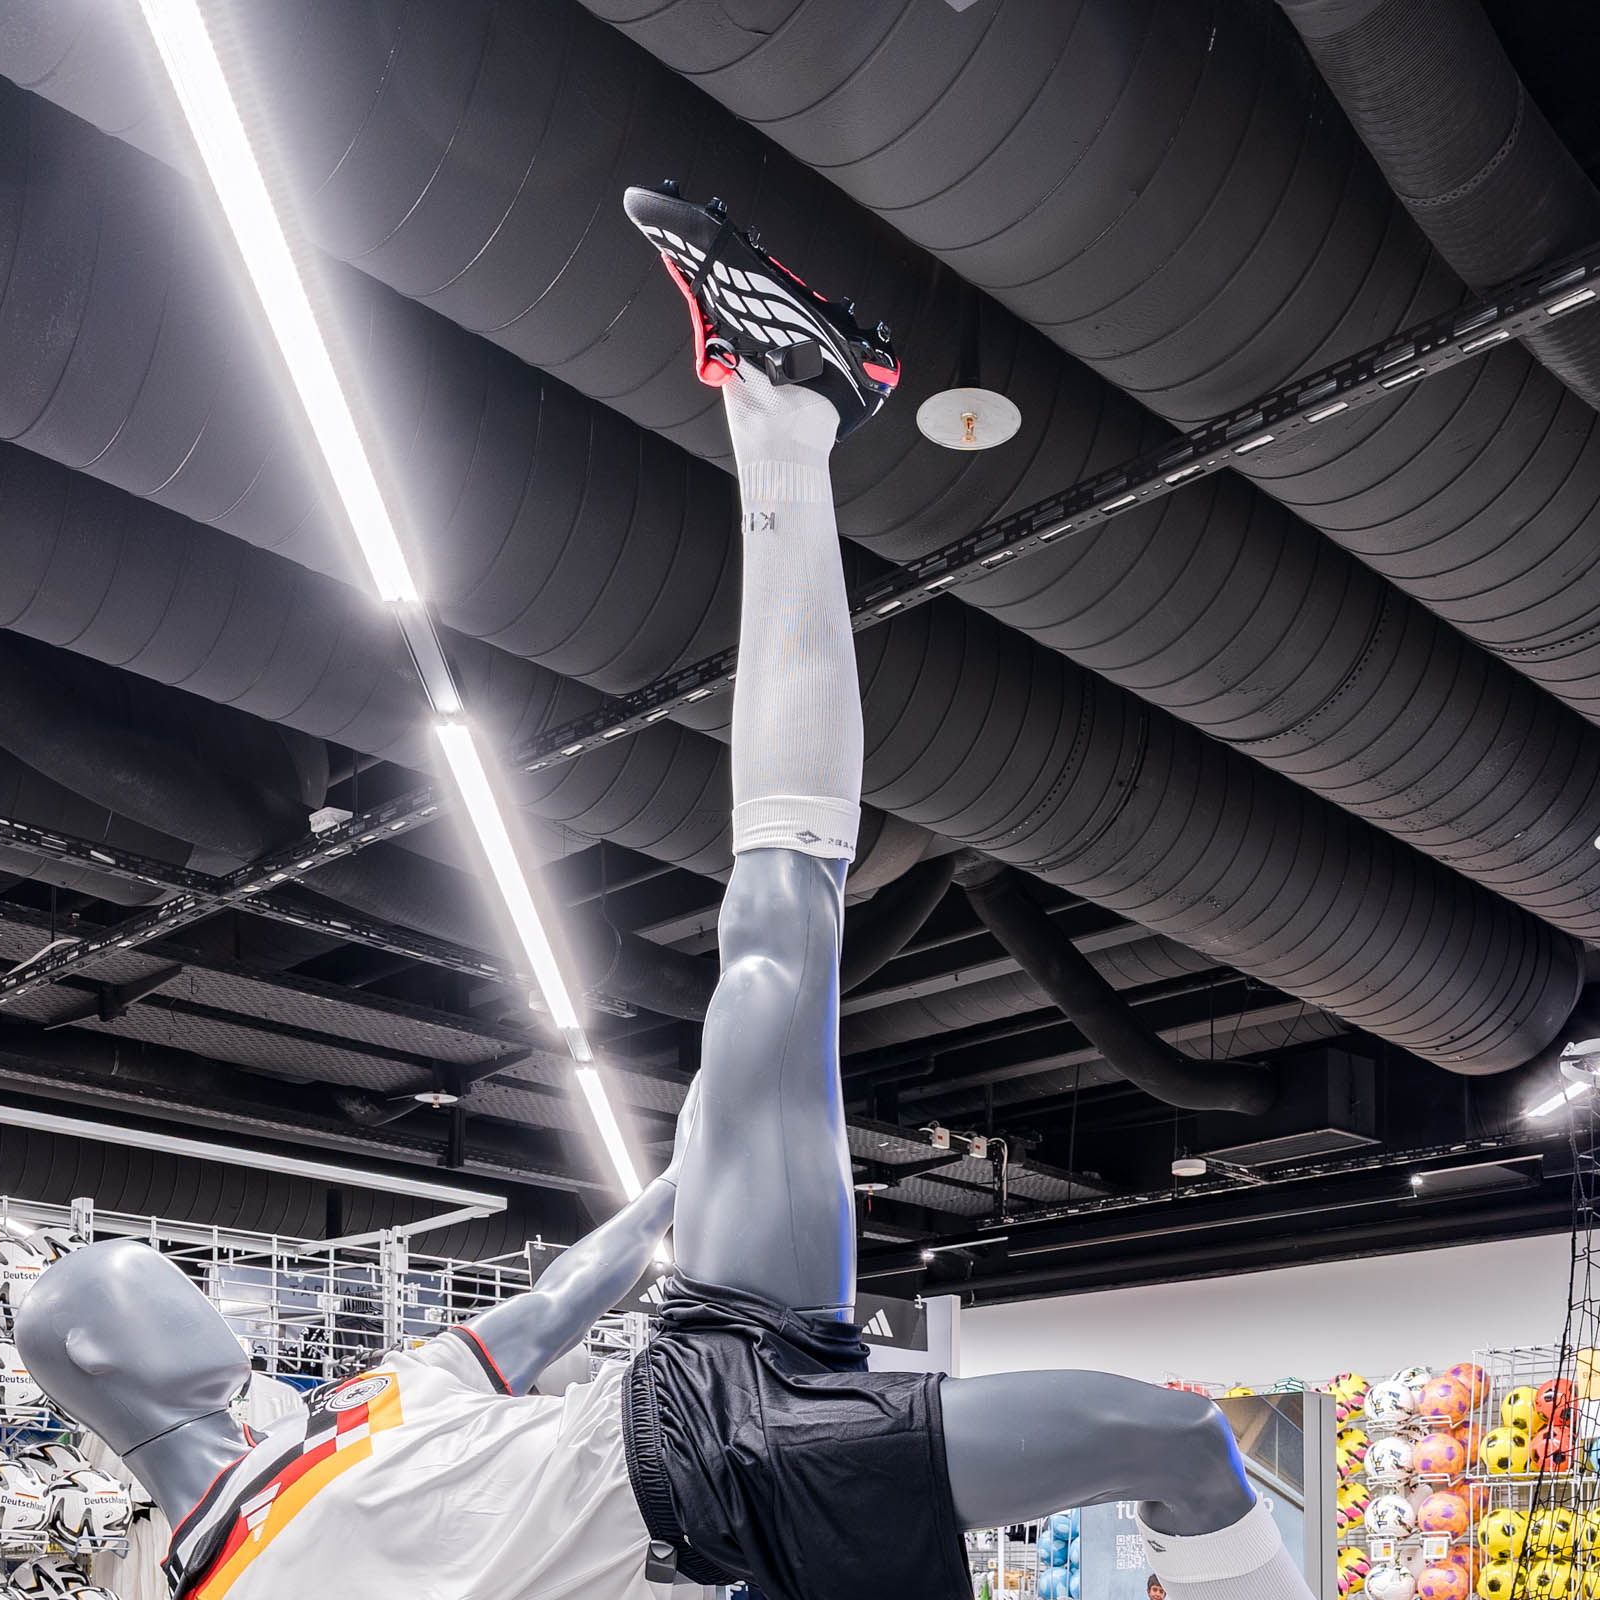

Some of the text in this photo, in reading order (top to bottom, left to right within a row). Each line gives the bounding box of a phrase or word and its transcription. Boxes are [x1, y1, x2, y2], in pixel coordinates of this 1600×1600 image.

[3, 1270, 40, 1282] Deutsch
[0, 1374, 36, 1386] Deutsch
[1, 1496, 46, 1512] Deutschland
[84, 1496, 127, 1506] Deutschland
